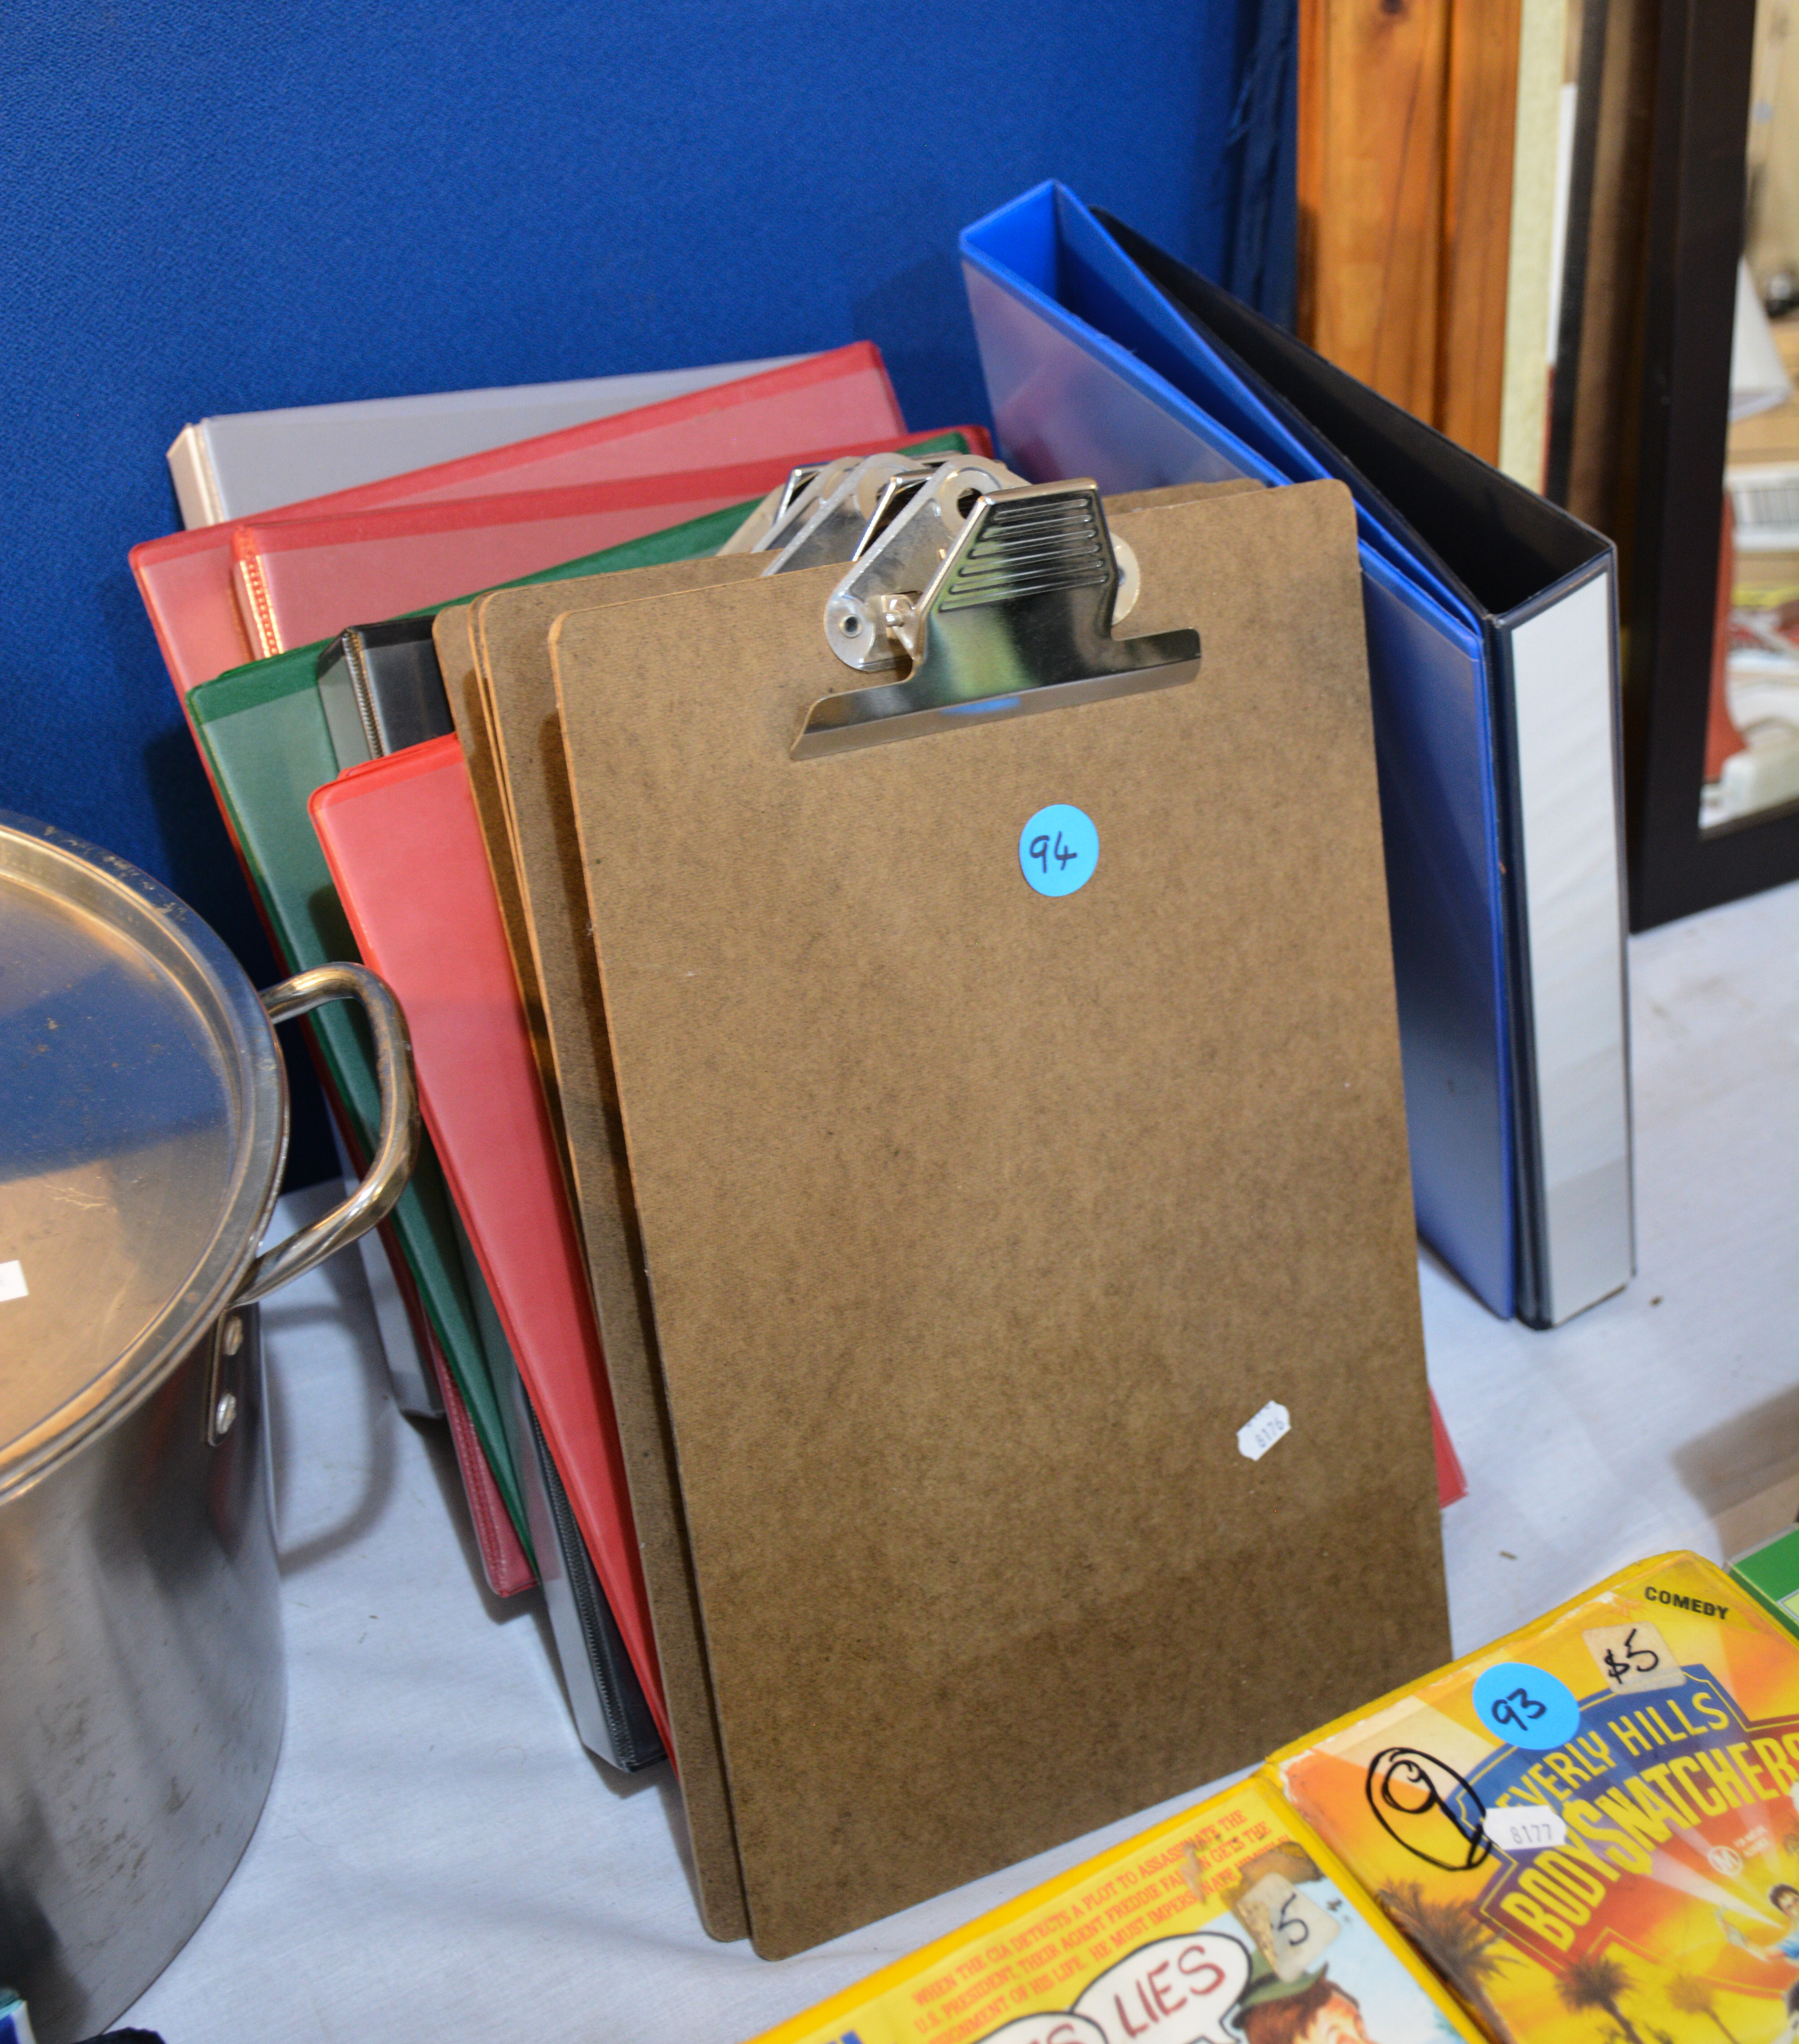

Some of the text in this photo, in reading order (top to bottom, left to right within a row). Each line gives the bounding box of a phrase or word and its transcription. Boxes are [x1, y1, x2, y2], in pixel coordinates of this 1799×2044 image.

[1029, 831, 1077, 873] 94
[1645, 1586, 1728, 1619] COMEDY
[1604, 1628, 1659, 1684] $5
[1491, 1688, 1547, 1731] 93
[1495, 1692, 1729, 1813] VERLY HILLS
[1510, 1824, 1552, 1844] 8177
[913, 1973, 958, 2006] WHEN
[955, 1955, 988, 1981] THE
[986, 1944, 1013, 1962] CIA
[1010, 1910, 1072, 1952] DETECTS
[1072, 1904, 1085, 1919] A
[1082, 1881, 1119, 1910] PLOT
[1116, 1871, 1138, 1891] TO
[1217, 1809, 1247, 1831] THE
[1009, 1984, 1029, 2003] OF
[1028, 1974, 1056, 1995] HIS
[1089, 1941, 1113, 1961] HE
[1110, 1921, 1150, 1950] MUST
[1150, 1867, 1238, 1926] IMPERSNATE
[1017, 1943, 1061, 1974] THEIR
[1061, 1916, 1106, 1950] AGENT
[1104, 1883, 1163, 1924] FREDDIE
[1210, 1836, 1245, 1863] GETS
[1243, 1821, 1272, 1843] THE
[1114, 1944, 1226, 2039] LIES
